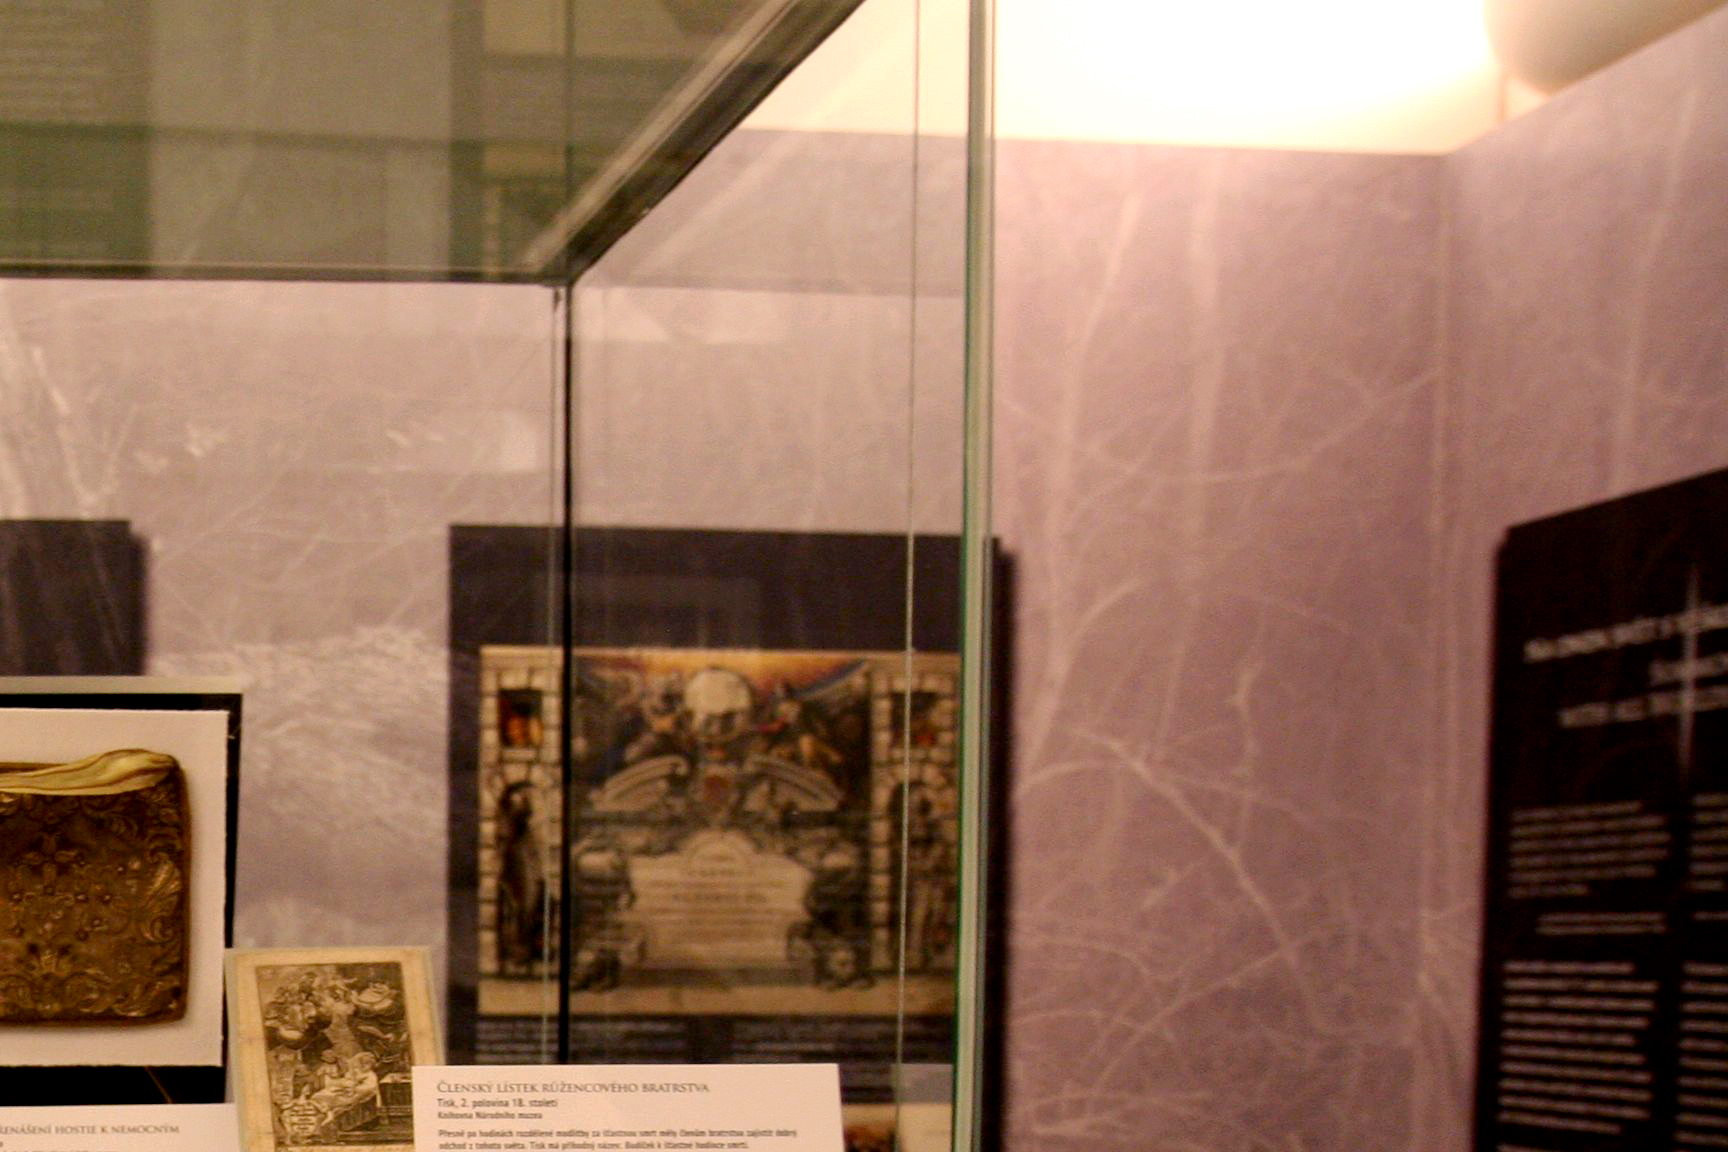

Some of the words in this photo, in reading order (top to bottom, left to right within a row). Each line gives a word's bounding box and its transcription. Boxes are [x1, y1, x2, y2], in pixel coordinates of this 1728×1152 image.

[642, 1081, 710, 1092] BRATRSTVA
[472, 1098, 510, 1108] polovina
[55, 1124, 96, 1135] HOSTIE
